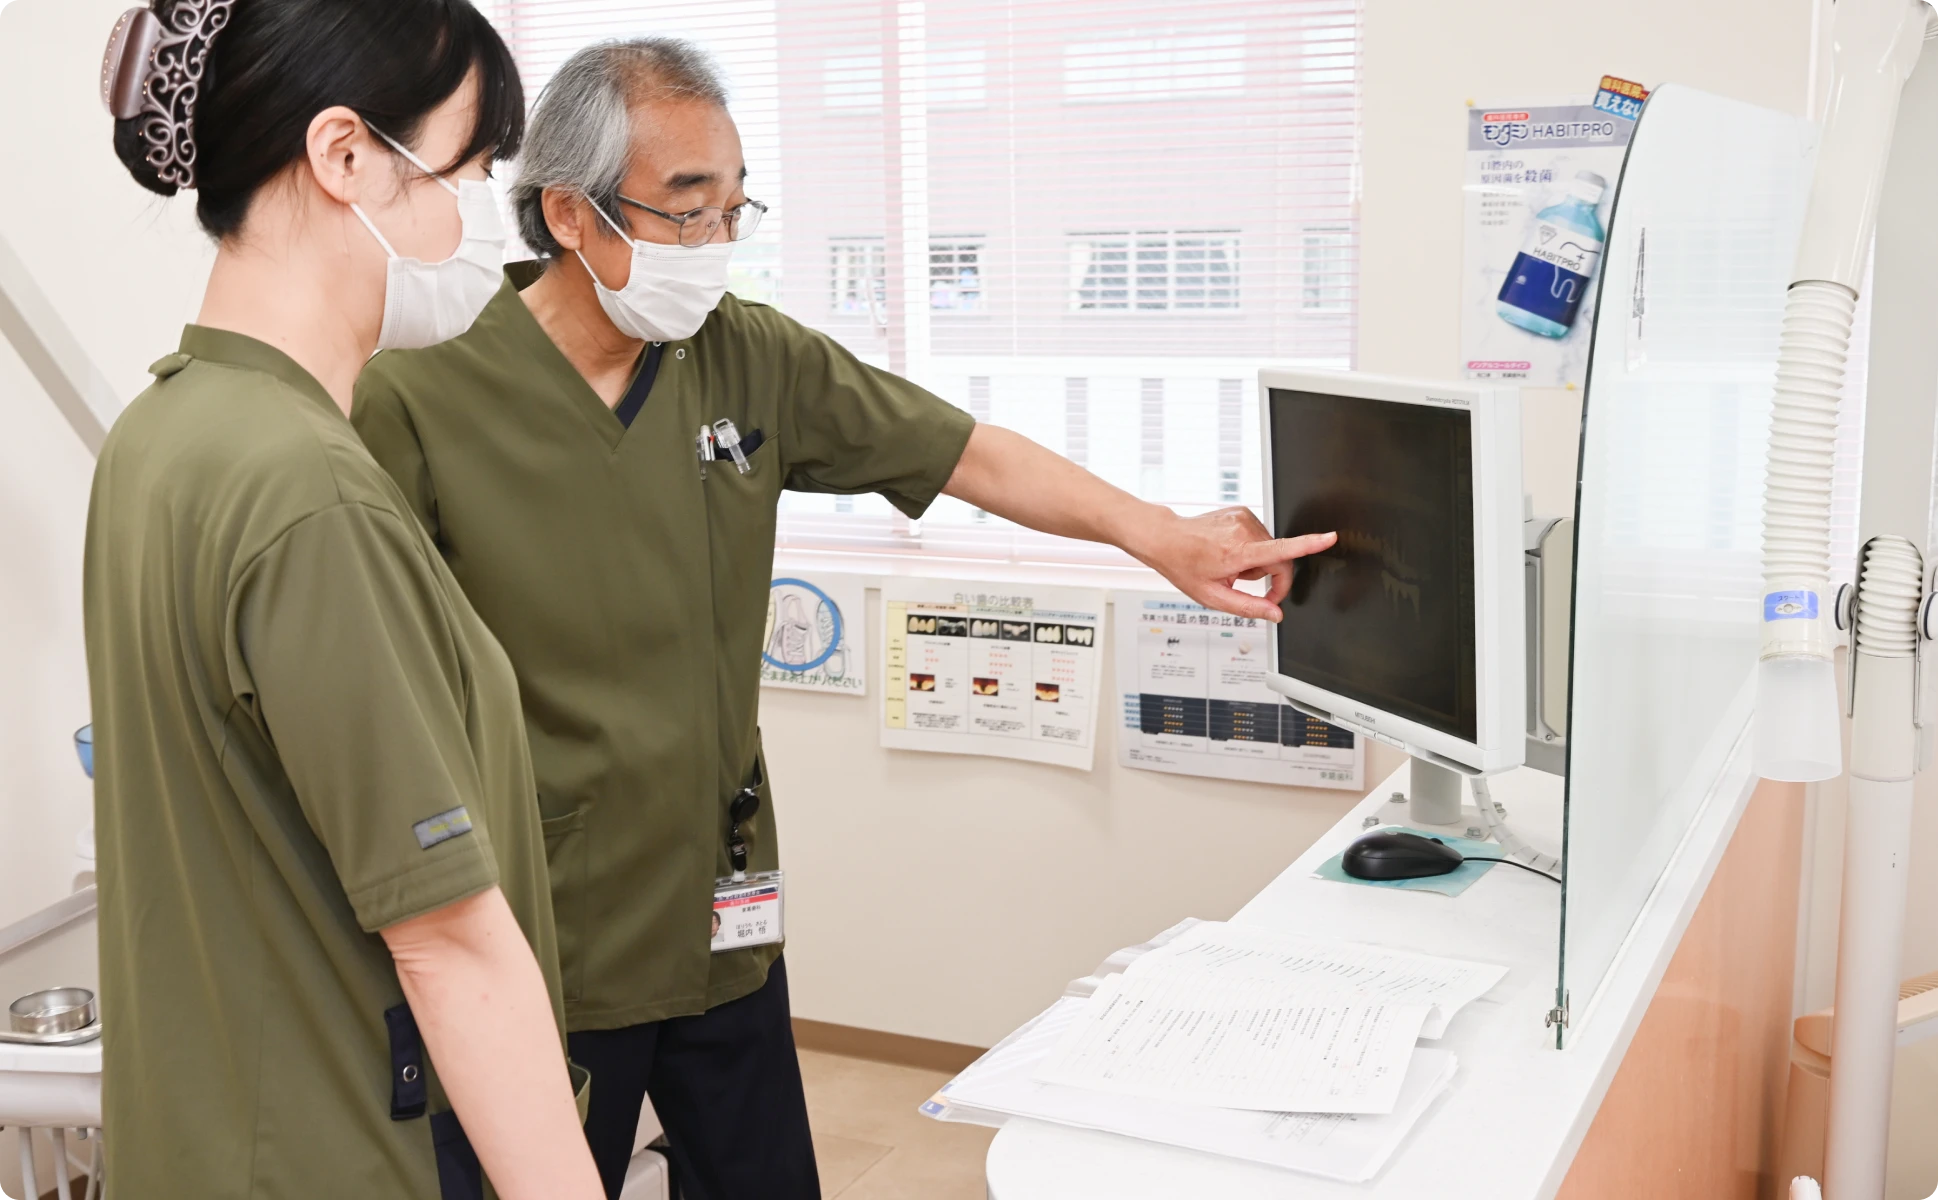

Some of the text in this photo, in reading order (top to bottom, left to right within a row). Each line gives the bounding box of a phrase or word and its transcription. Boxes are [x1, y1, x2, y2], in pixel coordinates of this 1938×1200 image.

[1483, 122, 1613, 146] モンダミン HABITPRO
[1480, 160, 1524, 170] 口腔内の
[1533, 246, 1581, 272] HABITPRO
[954, 592, 1033, 610] 白い歯の比較表
